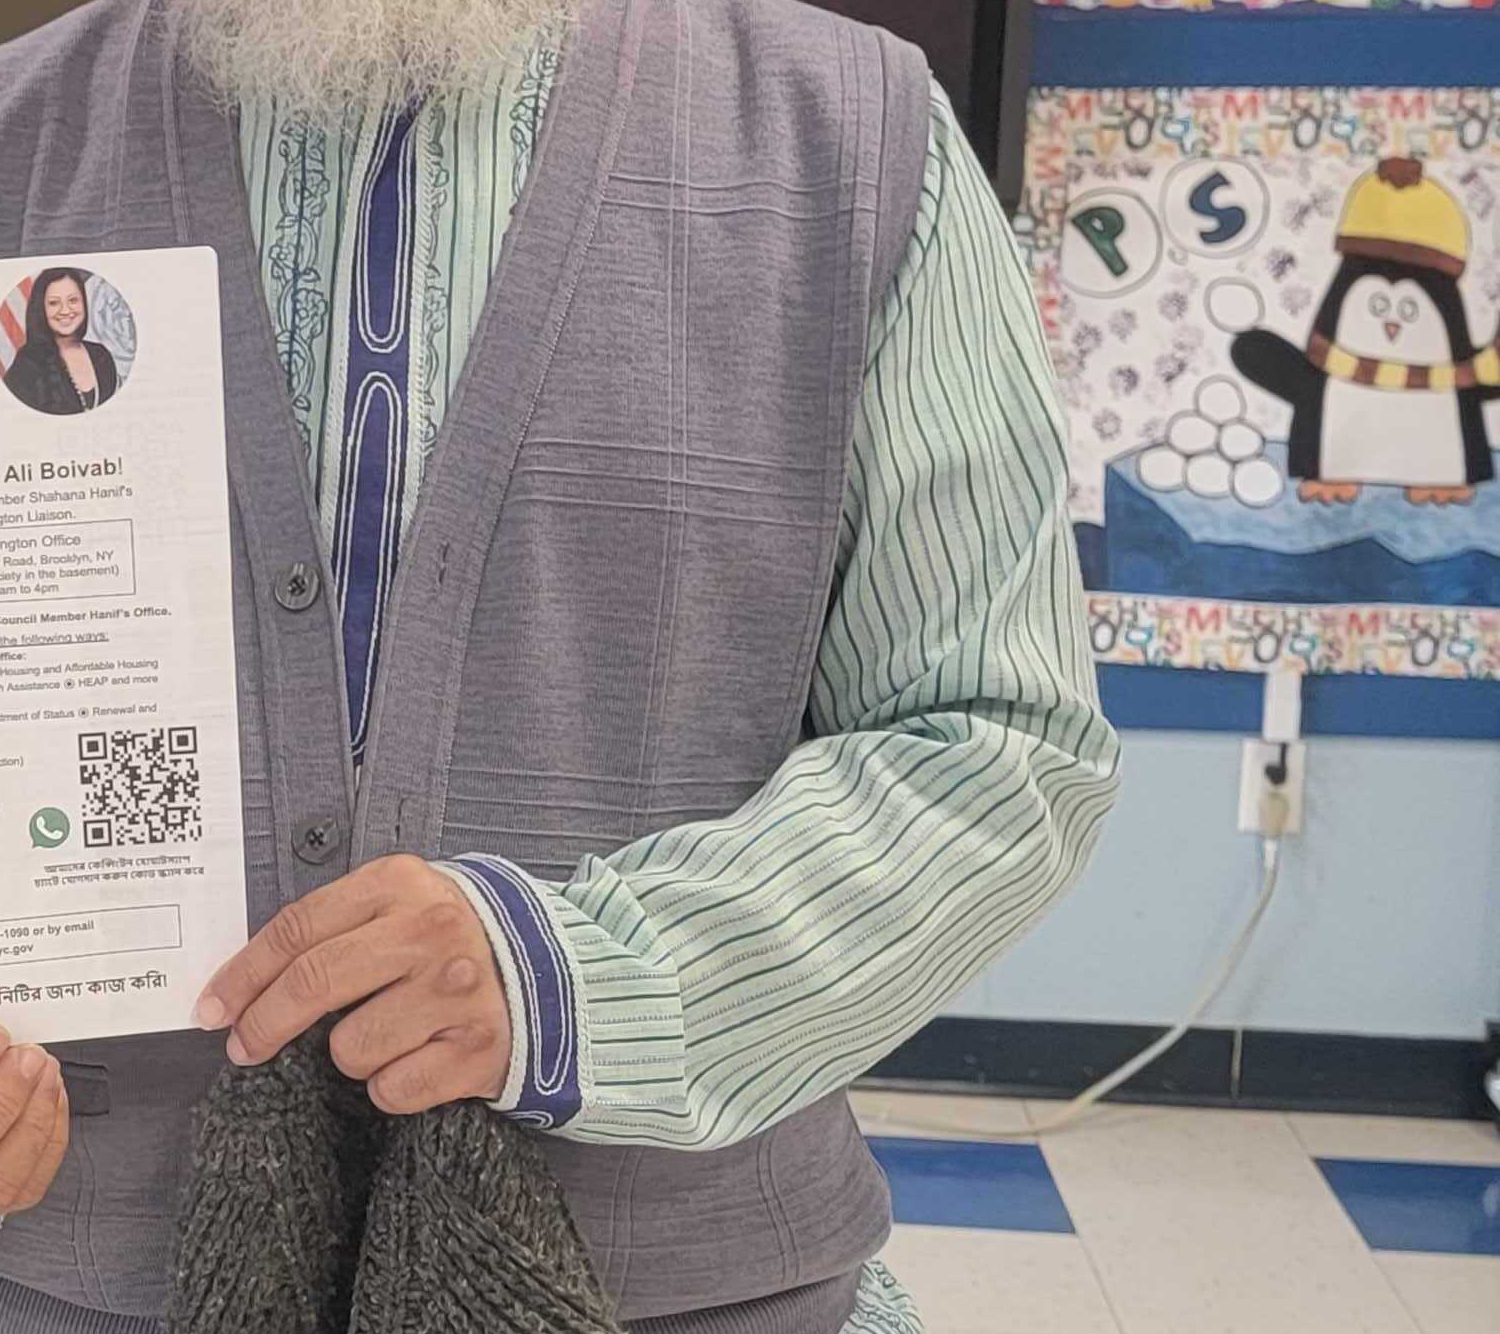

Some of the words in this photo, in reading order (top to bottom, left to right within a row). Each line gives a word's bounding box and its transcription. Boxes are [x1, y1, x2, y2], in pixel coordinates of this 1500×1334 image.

[5, 465, 32, 482] Ali
[41, 458, 121, 479] Boivab!
[30, 489, 85, 502] Shahana
[90, 485, 132, 499] Hanif's
[28, 509, 75, 522] Liaison.
[42, 533, 80, 547] Office
[4, 555, 36, 567] Road,
[40, 552, 92, 565] Brooklyn,
[97, 550, 113, 561] NY
[20, 583, 31, 594] to
[34, 582, 58, 595] 4pm
[41, 610, 85, 622] Member
[90, 607, 130, 619] Hanif's
[134, 605, 171, 617] Office.
[33, 926, 44, 935] or
[48, 923, 60, 936] by
[65, 919, 94, 932] email
